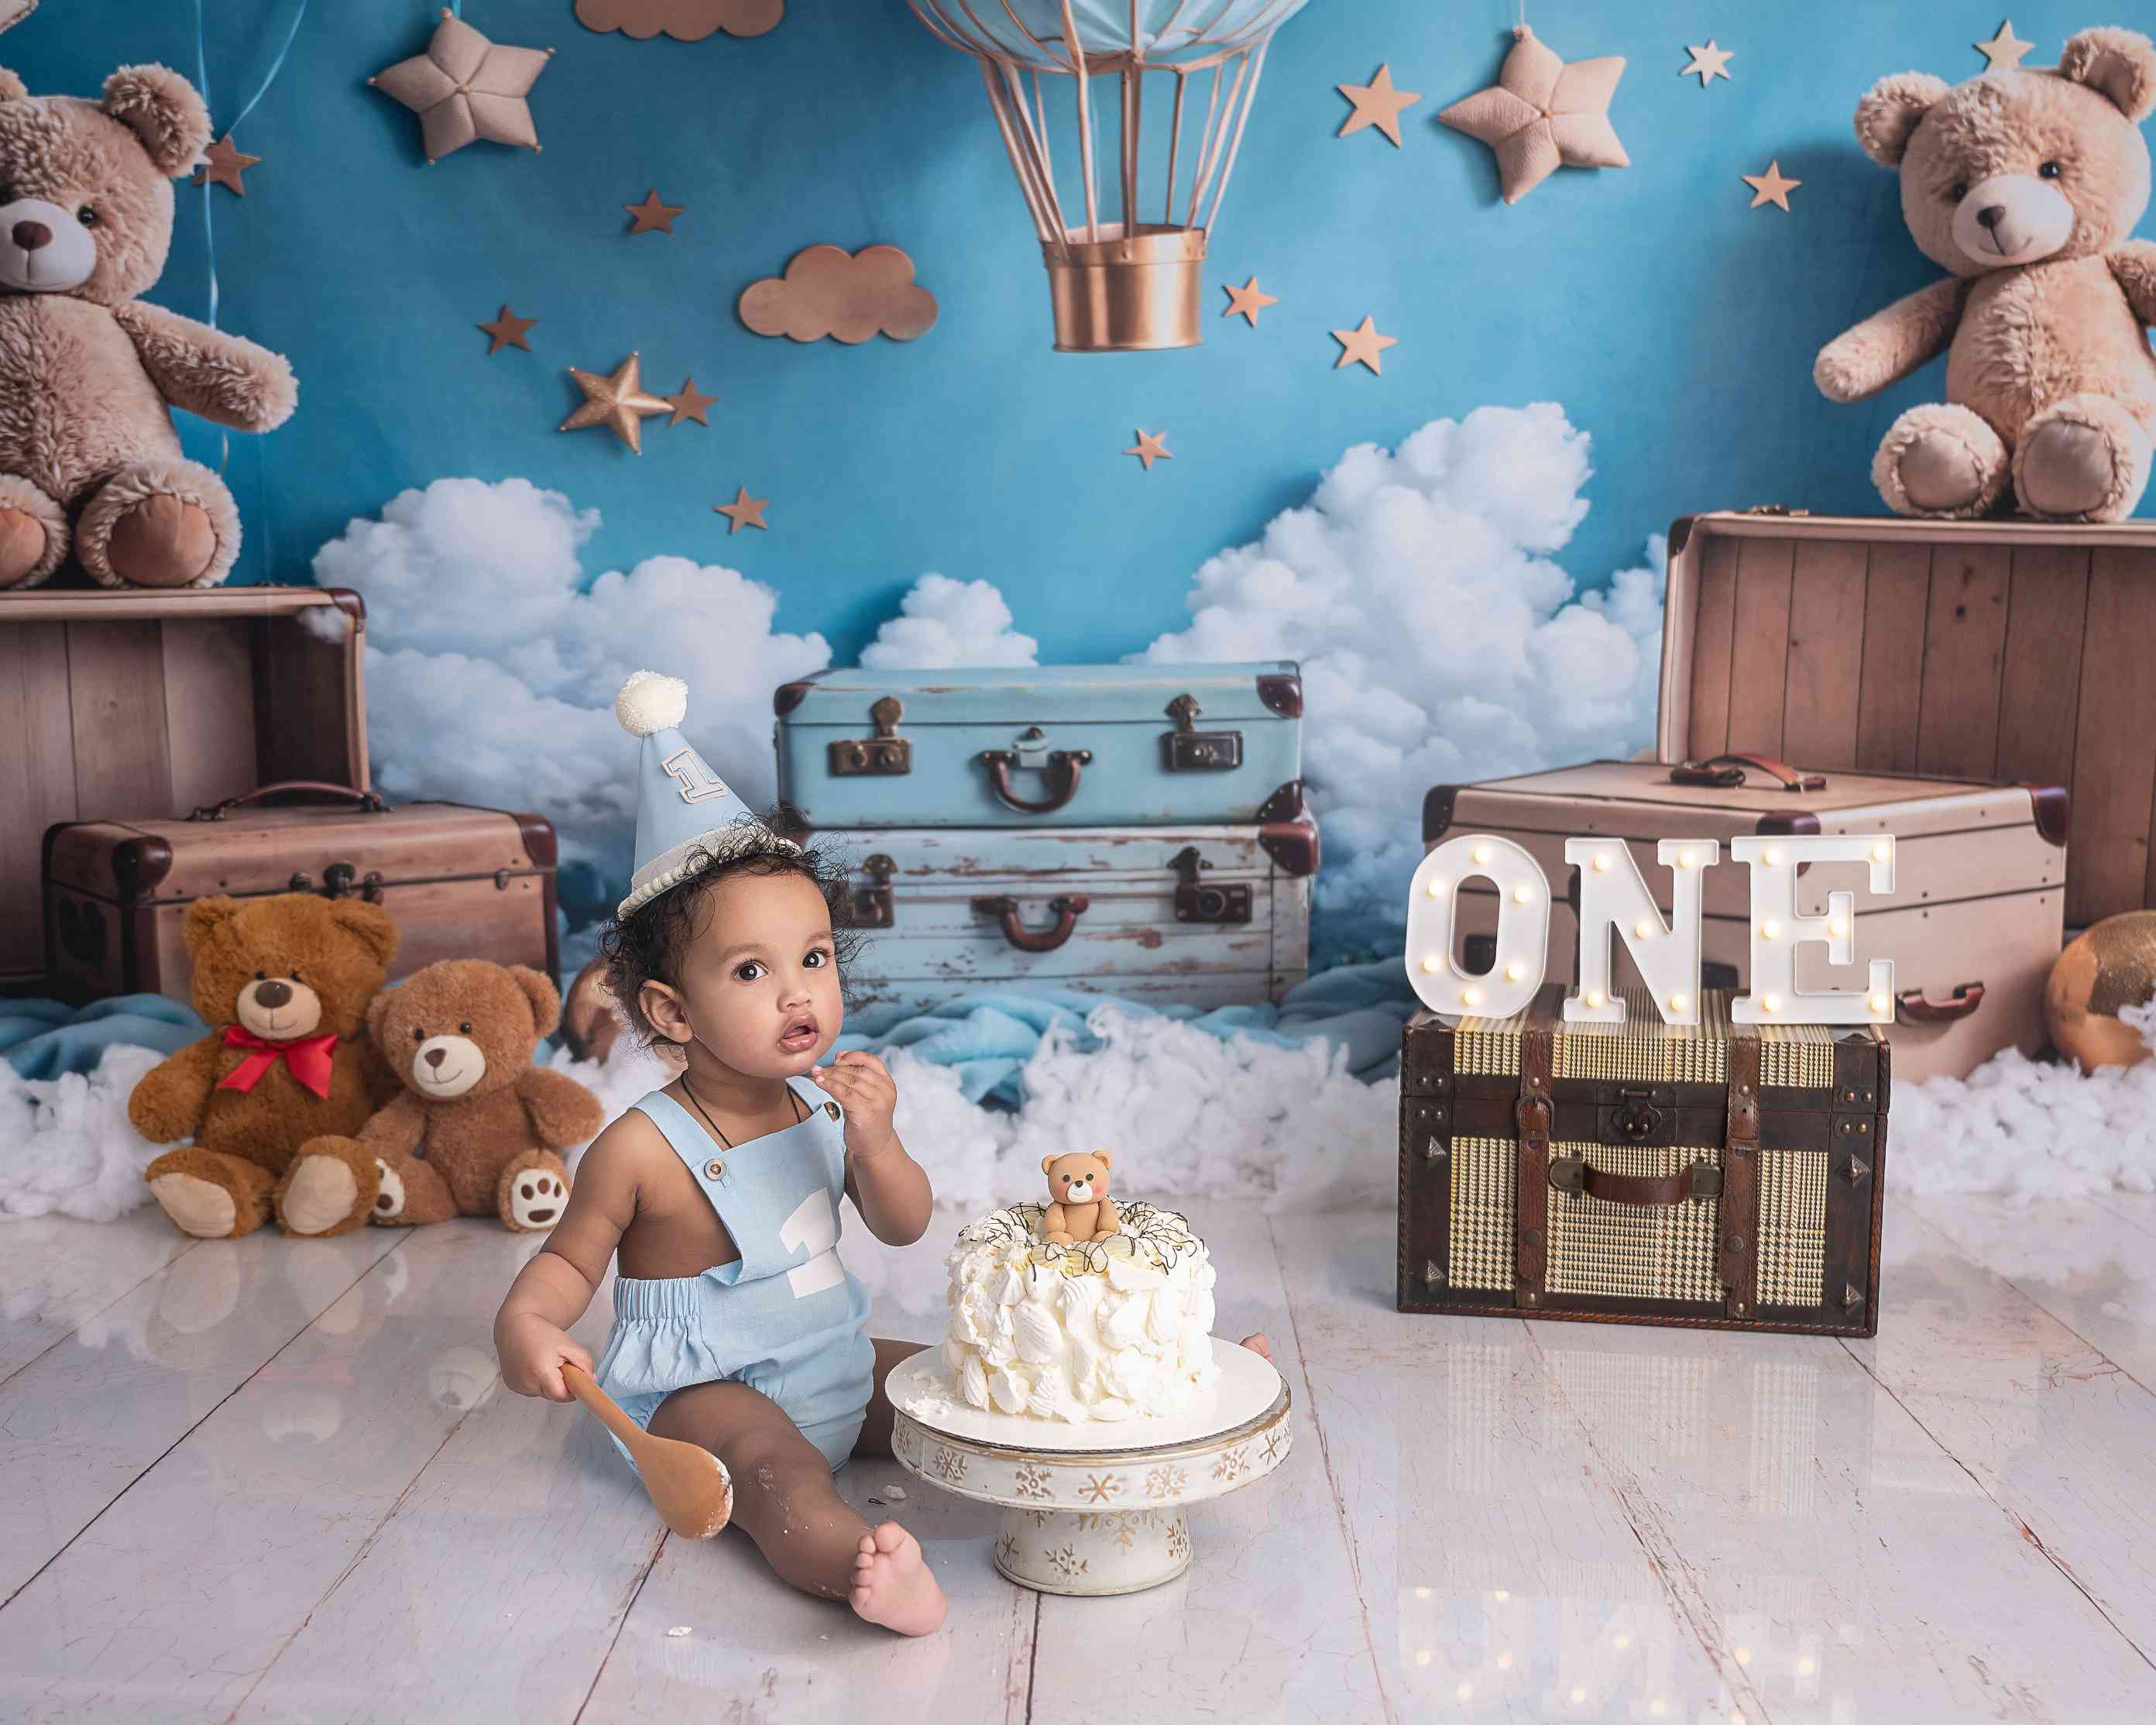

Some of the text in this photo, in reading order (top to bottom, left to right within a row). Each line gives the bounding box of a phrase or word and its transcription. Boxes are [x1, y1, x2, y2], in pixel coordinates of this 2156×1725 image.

[662, 747, 727, 804] 1
[1405, 834, 1895, 1025] ONE
[780, 1187, 845, 1299] 1
